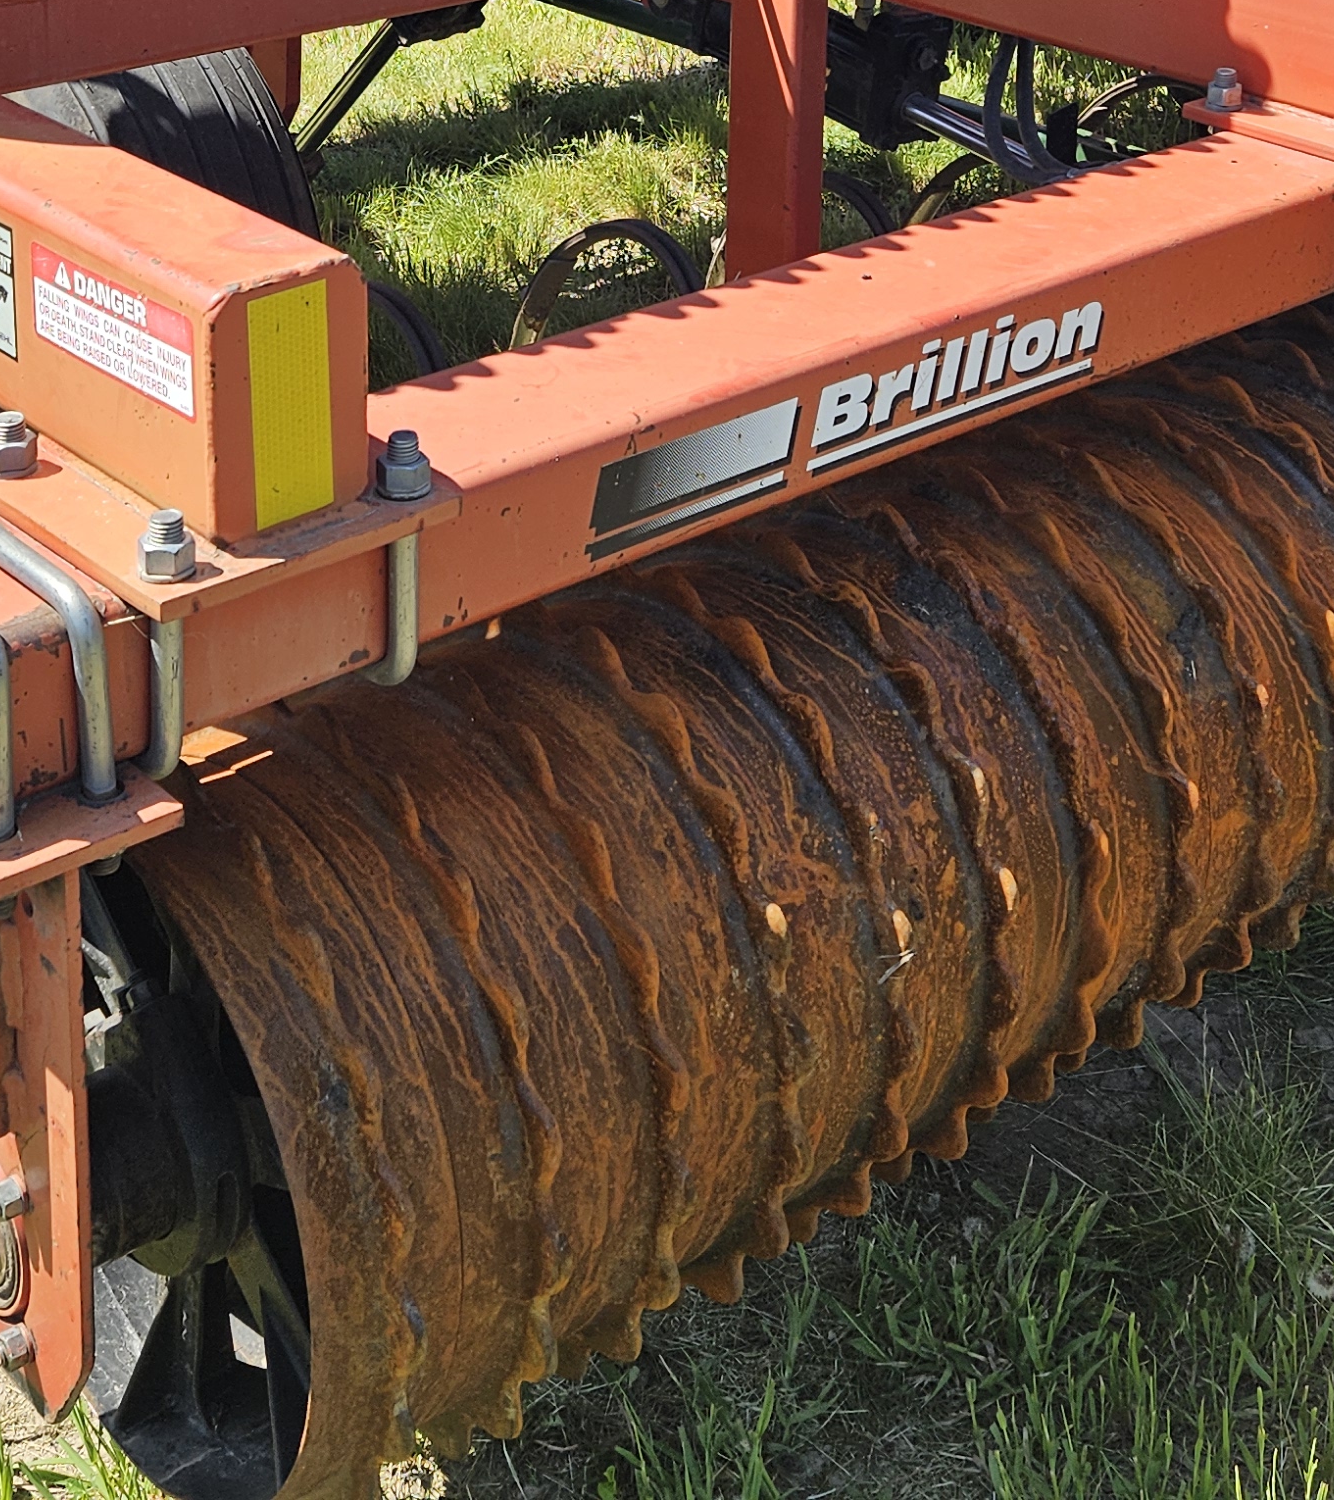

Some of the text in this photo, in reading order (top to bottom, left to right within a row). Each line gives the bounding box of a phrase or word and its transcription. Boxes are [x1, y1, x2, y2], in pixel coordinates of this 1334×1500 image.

[37, 284, 187, 374] FALLING WINGS CAN CAUSE INJURY
[72, 268, 147, 329] DANGER
[38, 301, 49, 319] OR
[78, 322, 106, 349] STAND
[106, 336, 132, 363] CLEAR
[134, 350, 159, 377] WHEN
[159, 363, 187, 392] WINGS
[39, 318, 55, 338] ARE
[56, 327, 80, 352] BEING
[82, 340, 111, 368] RAISED
[113, 356, 125, 376] OR
[810, 301, 1102, 447] Brillion
